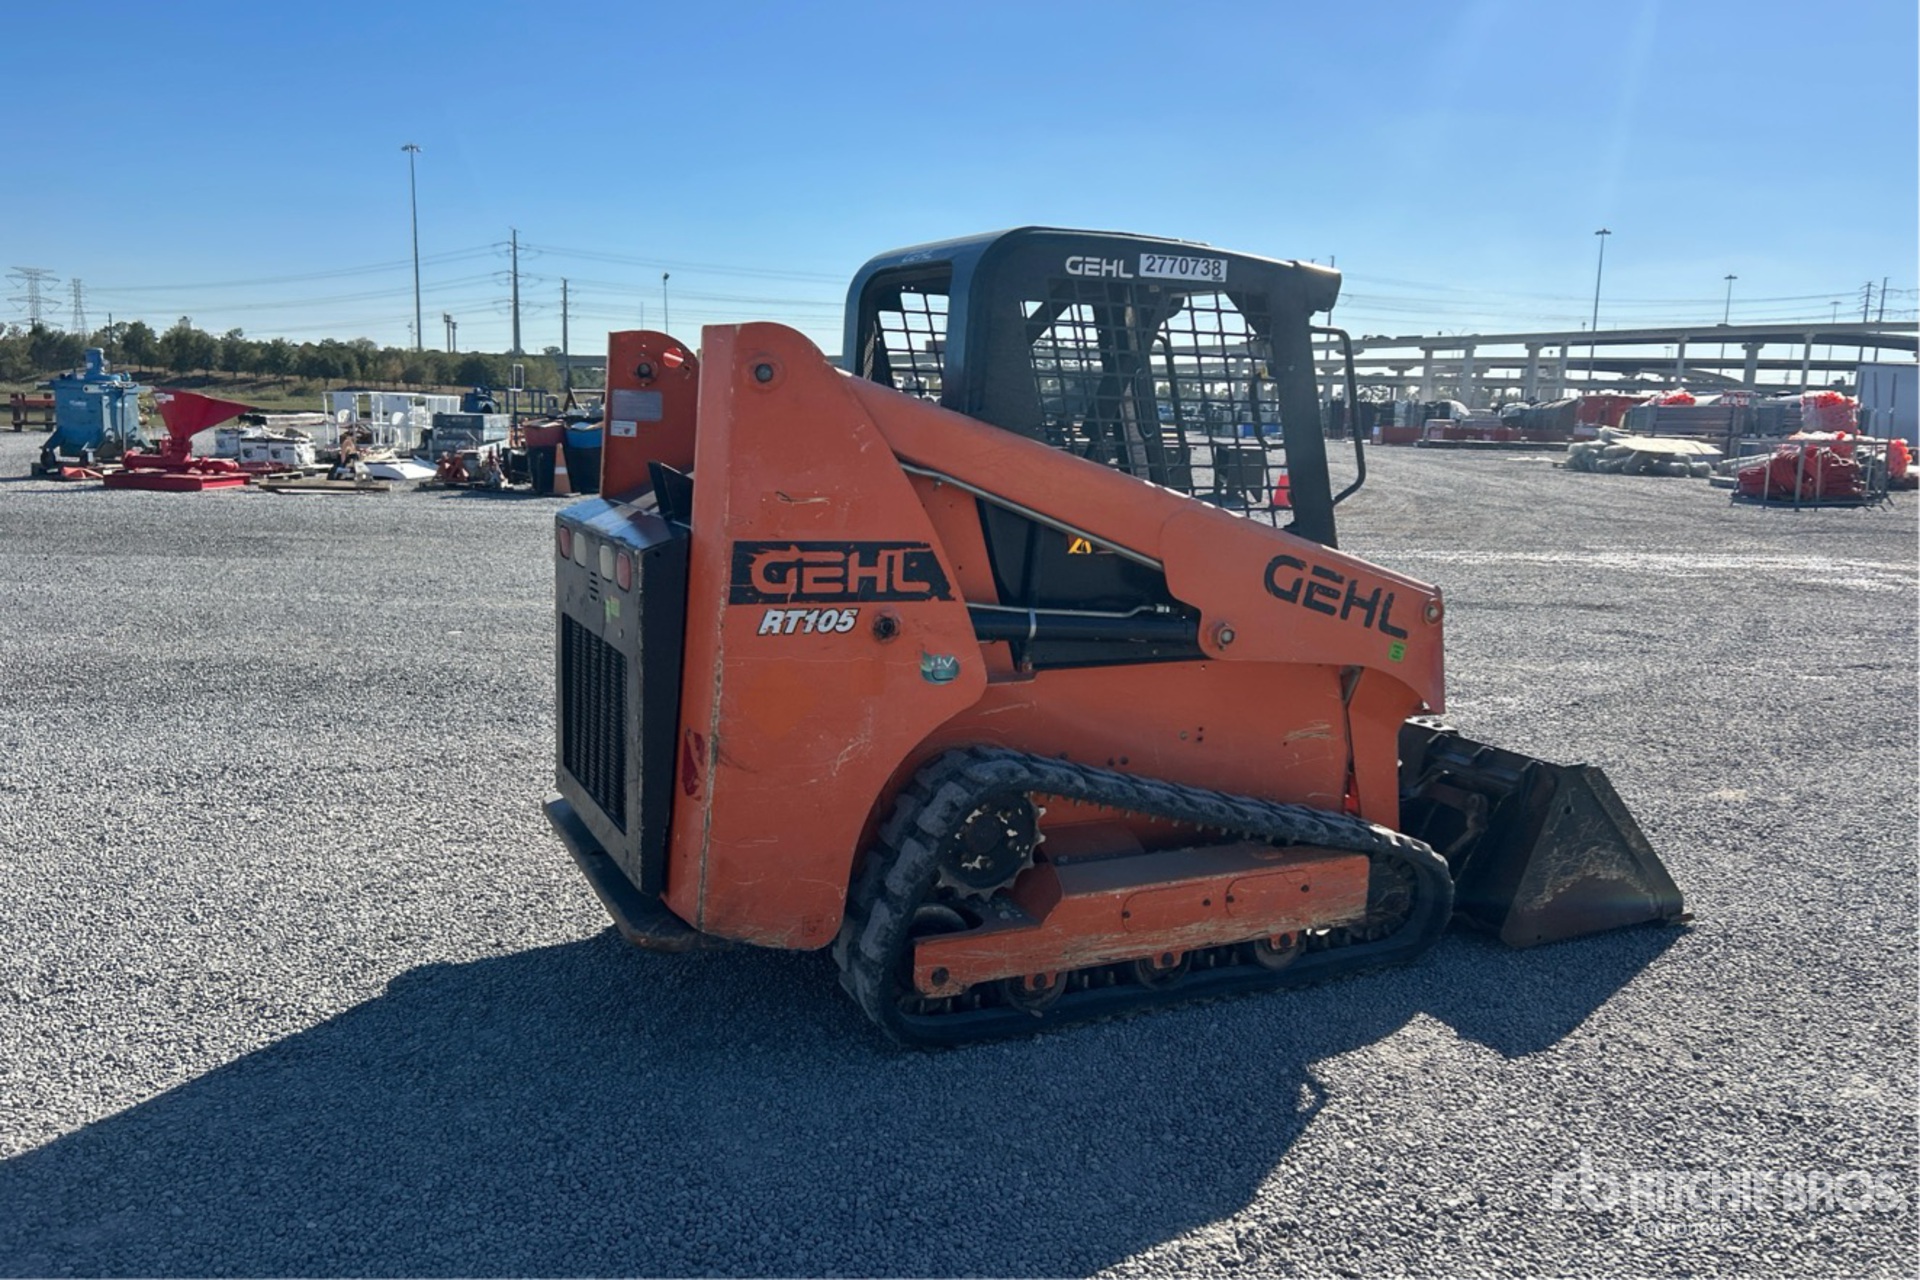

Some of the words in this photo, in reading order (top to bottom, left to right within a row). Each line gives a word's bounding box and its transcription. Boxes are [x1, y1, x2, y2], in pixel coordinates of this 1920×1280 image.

[1065, 255, 1134, 279] GEHL
[1144, 255, 1222, 277] 2770738
[751, 549, 931, 594] GEHL
[1264, 554, 1408, 640] GEHL
[757, 608, 860, 635] RT105
